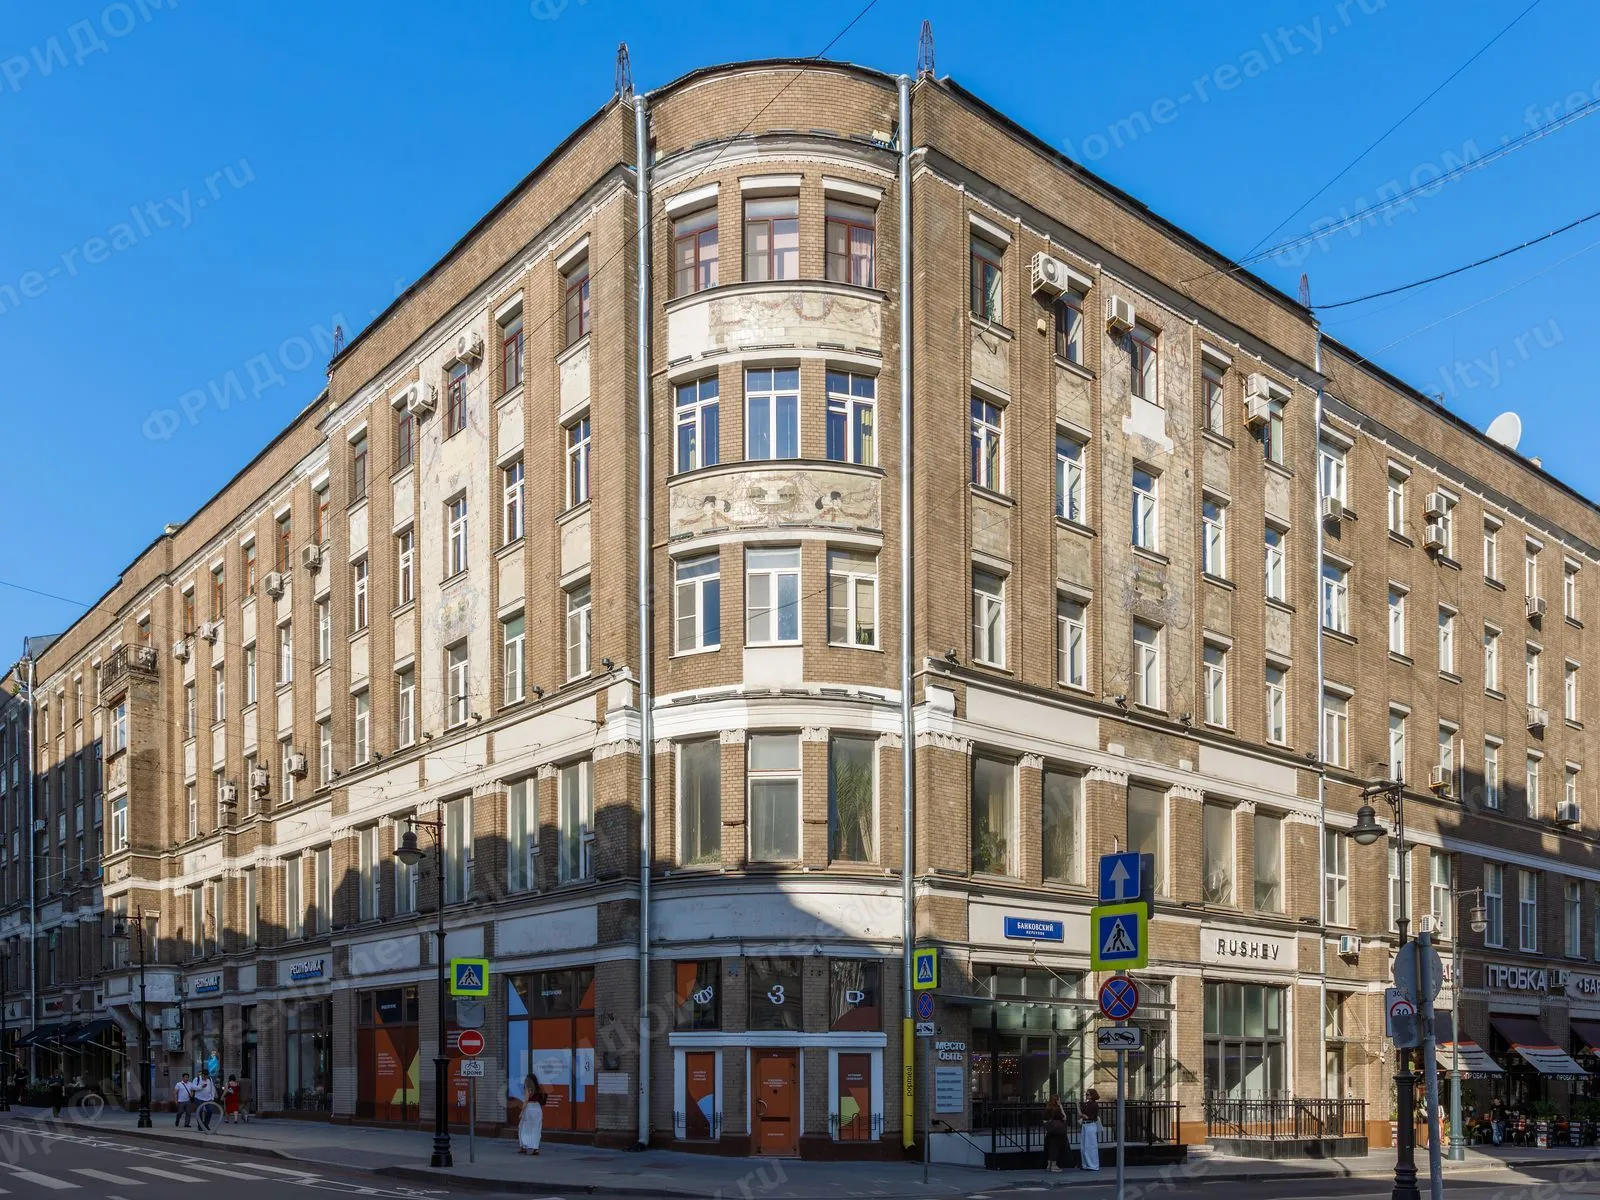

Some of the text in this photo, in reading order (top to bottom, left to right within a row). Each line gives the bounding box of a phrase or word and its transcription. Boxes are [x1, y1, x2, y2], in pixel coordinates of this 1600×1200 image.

[1017, 921, 1054, 932] БАНКОВСКИЙ
[1216, 938, 1280, 961] RUSHEV
[1487, 965, 1547, 992] ПРОБКА
